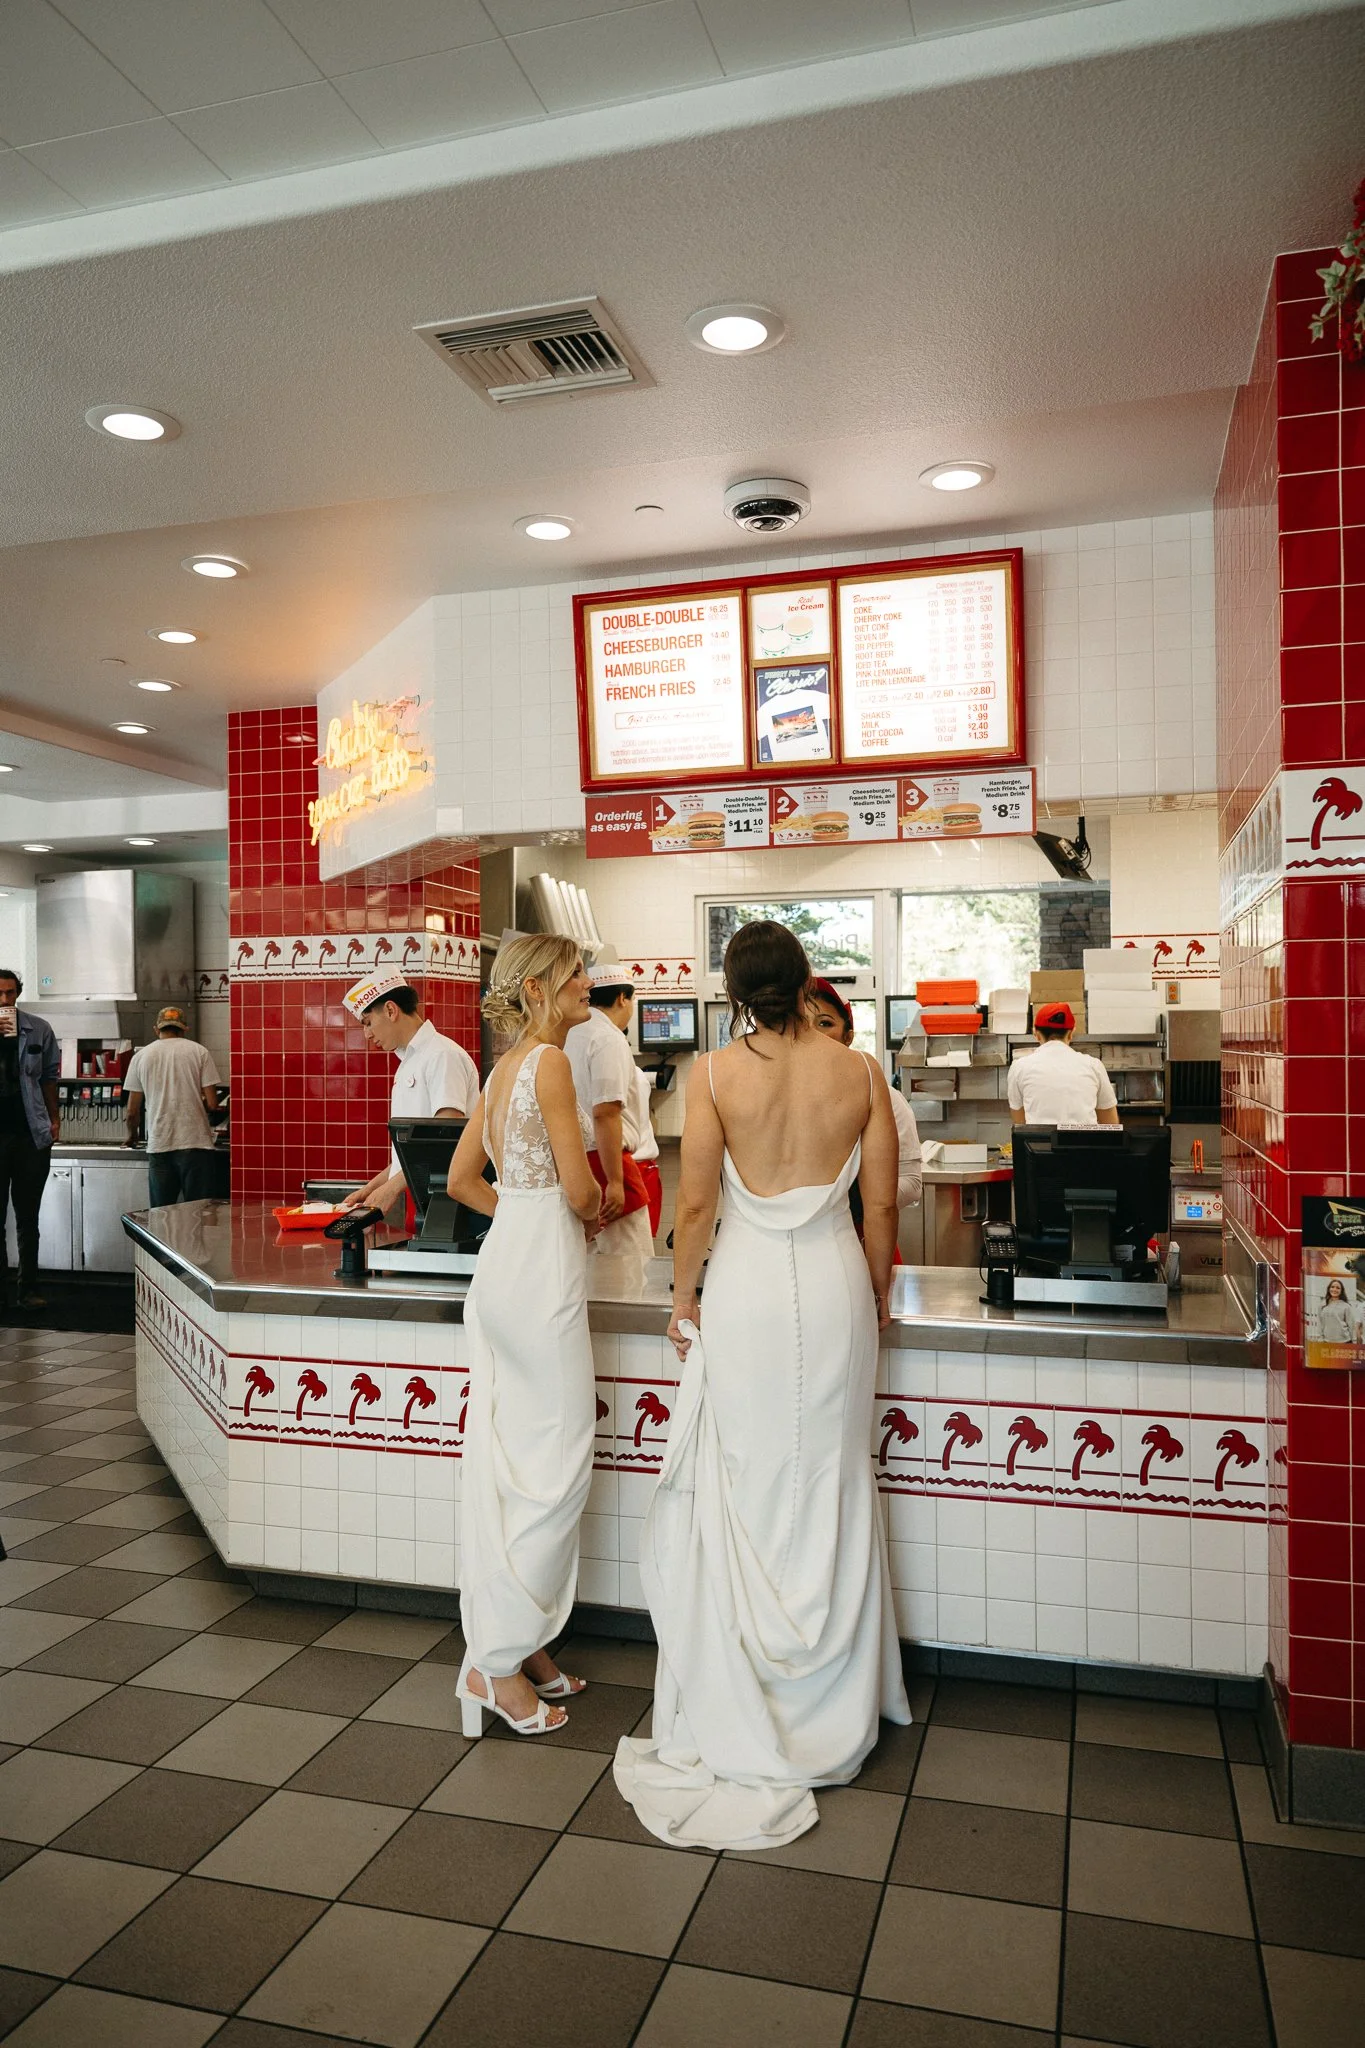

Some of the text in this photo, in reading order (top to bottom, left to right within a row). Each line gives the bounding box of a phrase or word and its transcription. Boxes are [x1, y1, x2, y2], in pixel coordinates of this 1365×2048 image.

[798, 596, 813, 604] Real
[853, 606, 872, 615] COKE
[980, 595, 992, 603] 520
[788, 602, 824, 612] Ice Cream
[602, 607, 705, 631] DOUBLE-DOUBLE
[710, 604, 728, 613] $6.25
[853, 614, 881, 624] CHERRY
[883, 612, 903, 621] COKE
[980, 604, 992, 612] 530
[854, 624, 869, 633] DIET
[872, 623, 890, 631] COKE
[855, 633, 877, 642] SEVEN
[879, 632, 888, 640] UP
[604, 634, 703, 656] CHEESEBURGER
[867, 641, 894, 650] PEPPER
[855, 652, 873, 660] ROOT
[875, 650, 894, 658] BEER
[605, 658, 686, 678] HAMBURGER
[856, 661, 871, 669] ICED
[874, 660, 887, 668] TEA
[856, 671, 871, 679] PINK
[874, 667, 912, 677] LEMONADE
[856, 680, 870, 688] LITE
[872, 678, 887, 686] PINK
[889, 675, 926, 685] LEMONADE
[984, 670, 992, 678] 25
[606, 684, 656, 701] FRENCH
[660, 681, 696, 696] FRIES
[969, 686, 991, 695] $2.80
[861, 710, 891, 720] SHAKES
[861, 721, 879, 729] MILK
[861, 730, 876, 738] HOT
[878, 728, 904, 737] COCOA
[968, 721, 988, 730] $2.40
[862, 738, 889, 748] COFFEE
[905, 788, 919, 806] 3
[777, 796, 790, 813] 2
[594, 809, 643, 823] Ordering
[655, 804, 667, 821] 1
[590, 821, 647, 833] as easy as
